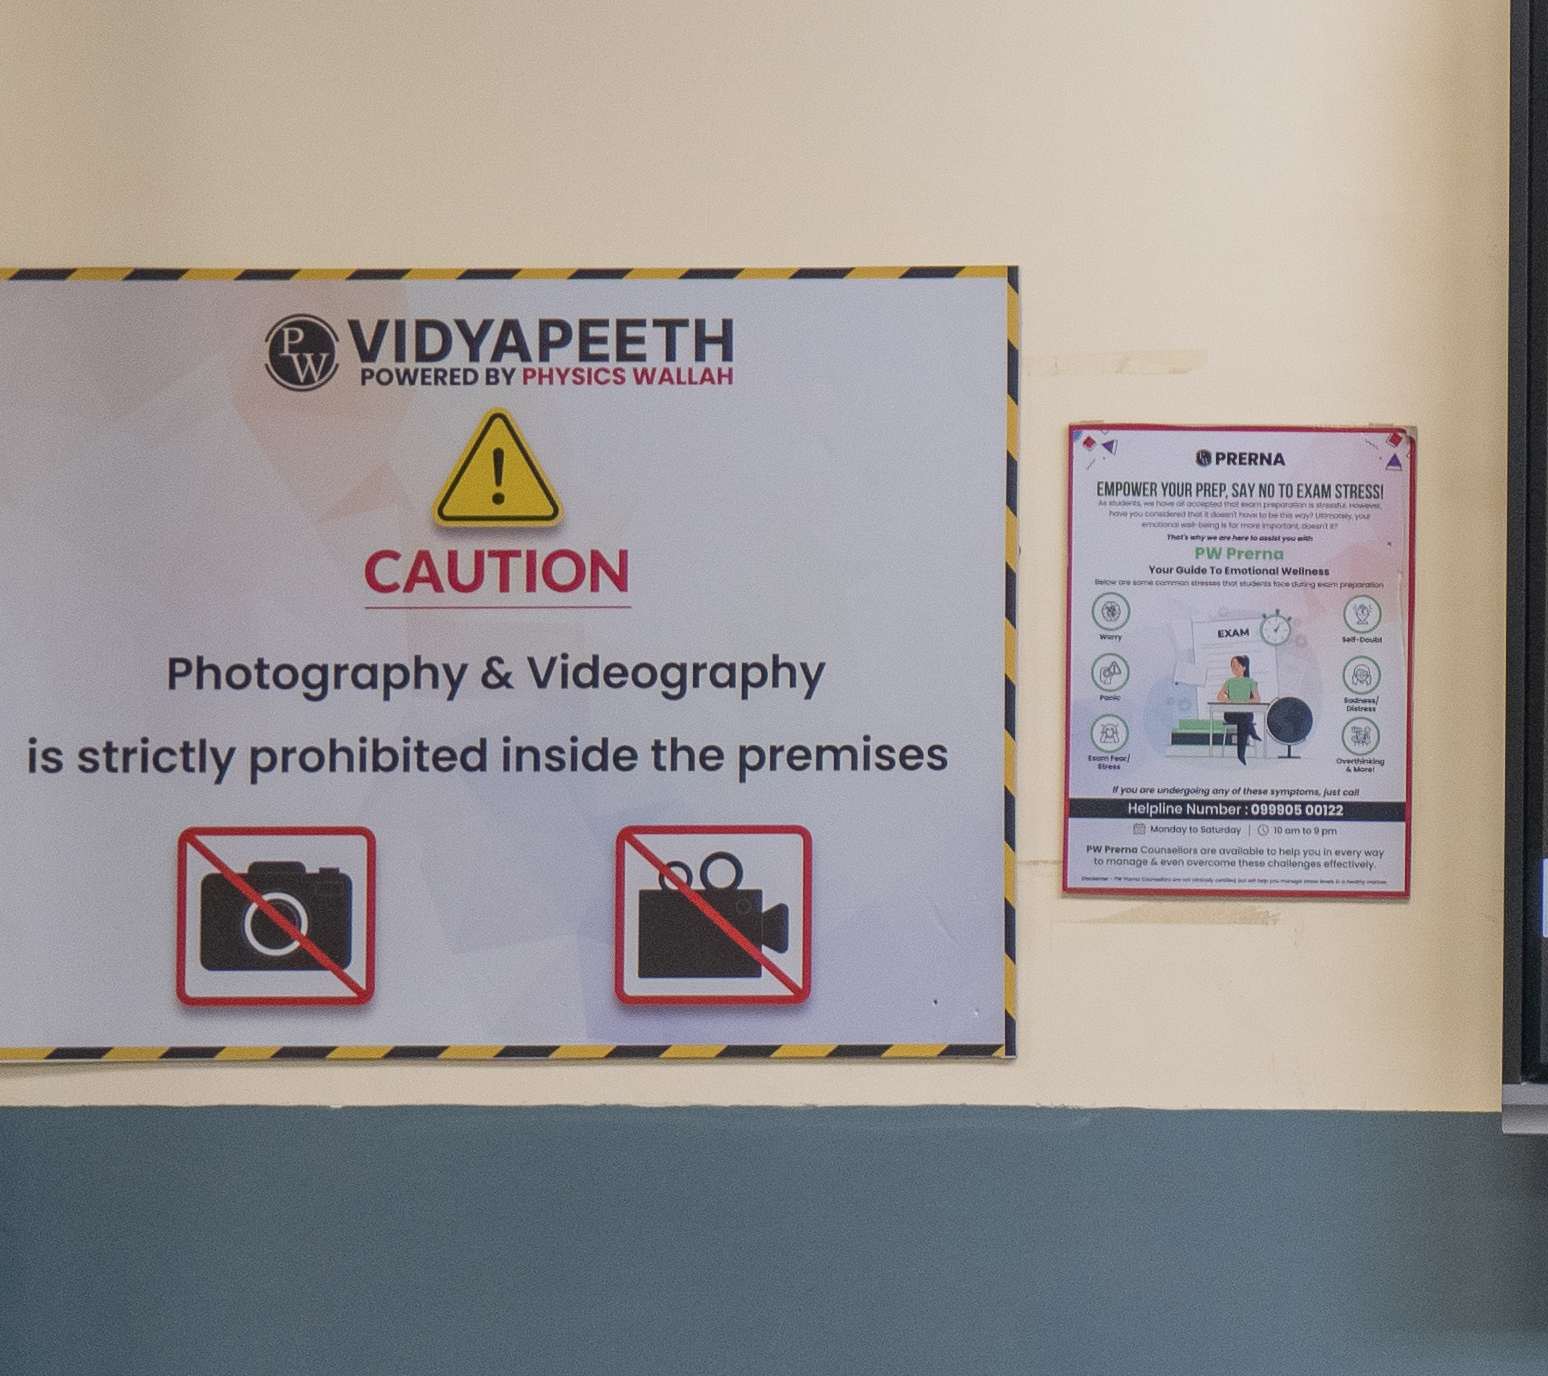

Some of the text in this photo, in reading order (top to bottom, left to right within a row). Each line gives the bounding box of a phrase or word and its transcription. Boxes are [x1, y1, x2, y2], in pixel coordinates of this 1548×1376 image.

[347, 318, 733, 364] VIDYAPEETH
[360, 367, 733, 387] POWERED BY PHYSICS WALLAH
[1215, 451, 1286, 466] PRERNA
[1096, 481, 1384, 500] EMPOWER YOUR PREP, SAY NO TO EXAM STRESS!
[1194, 546, 1285, 561] PW Prerna
[364, 548, 629, 594] CAUTION
[1217, 628, 1250, 639] EXAM
[168, 652, 826, 703] Photography & Videography
[28, 734, 948, 786] is strictly prohibited inside the premises
[1127, 802, 1183, 818] Helpline
[1186, 803, 1242, 816] Number
